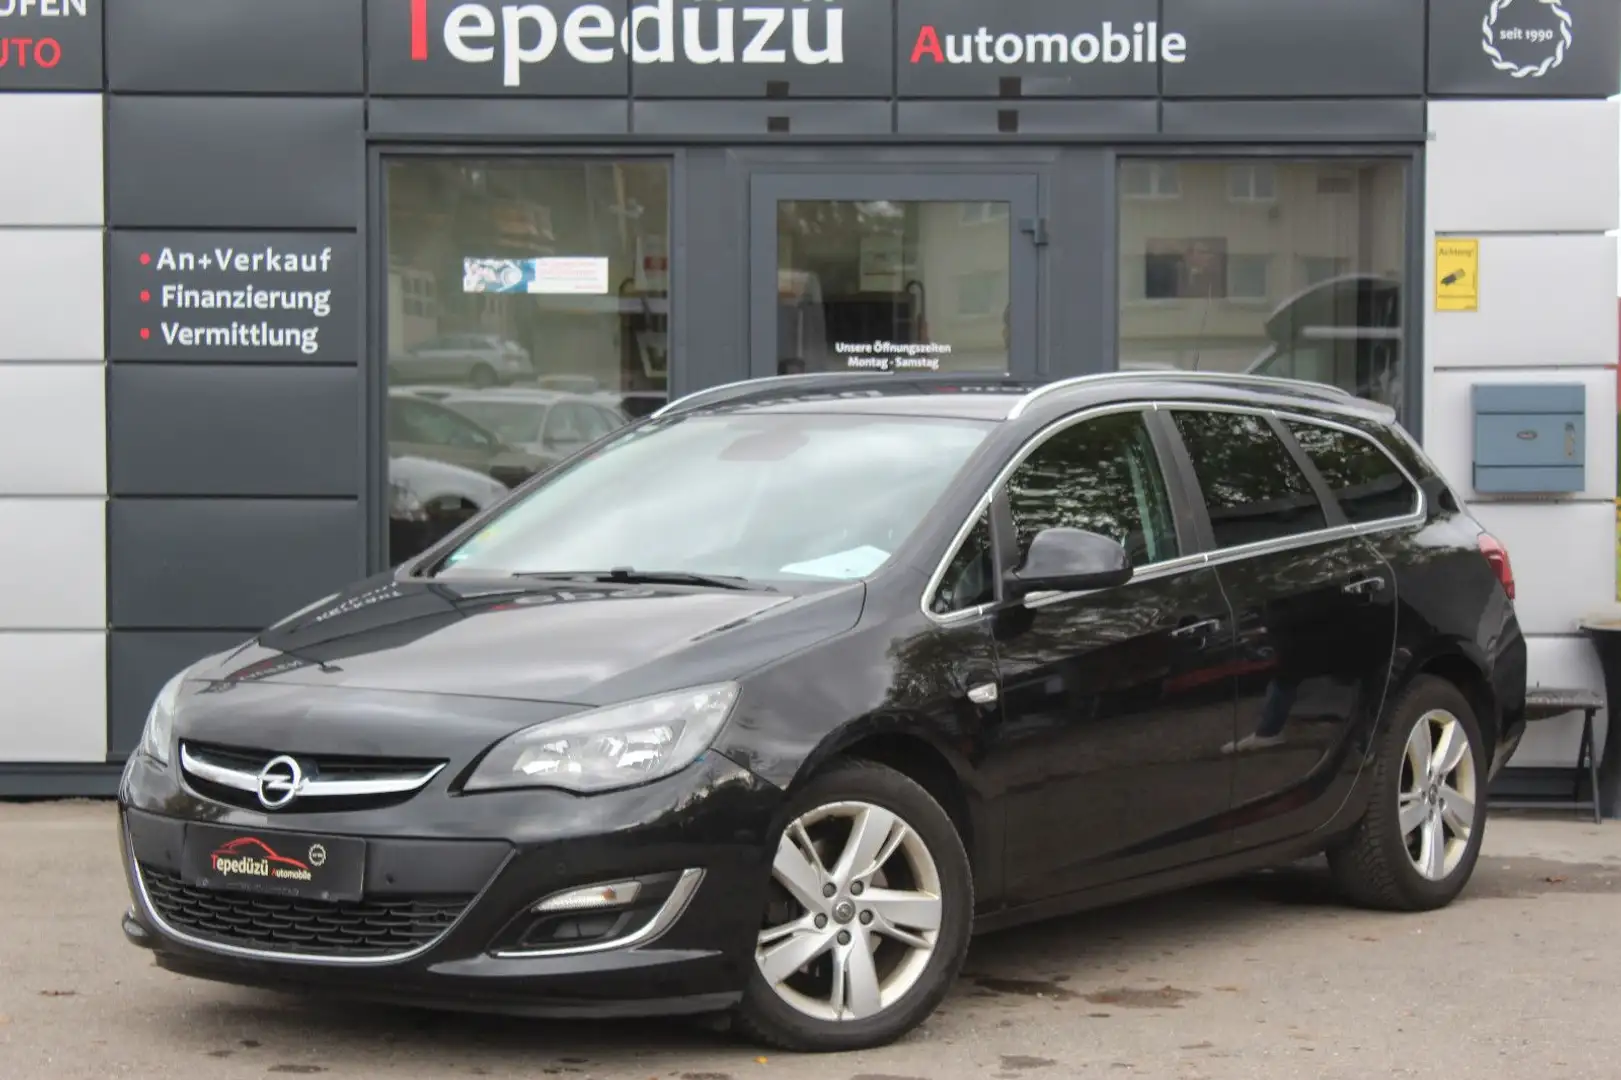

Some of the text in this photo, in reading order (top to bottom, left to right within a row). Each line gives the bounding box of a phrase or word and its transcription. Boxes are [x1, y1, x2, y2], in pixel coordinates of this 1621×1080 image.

[910, 21, 1187, 64] Automobile
[1499, 27, 1553, 42] seit 1990
[156, 247, 332, 272] An+Verkauf
[162, 284, 331, 317] Finanzierung
[161, 321, 319, 354] Vermittlung
[835, 339, 951, 355] Unsere Öffnungszeiten
[847, 356, 889, 370] Montag
[895, 356, 939, 370] Samstag
[211, 853, 269, 876] Tepedüzü
[271, 868, 312, 881] Automobile
